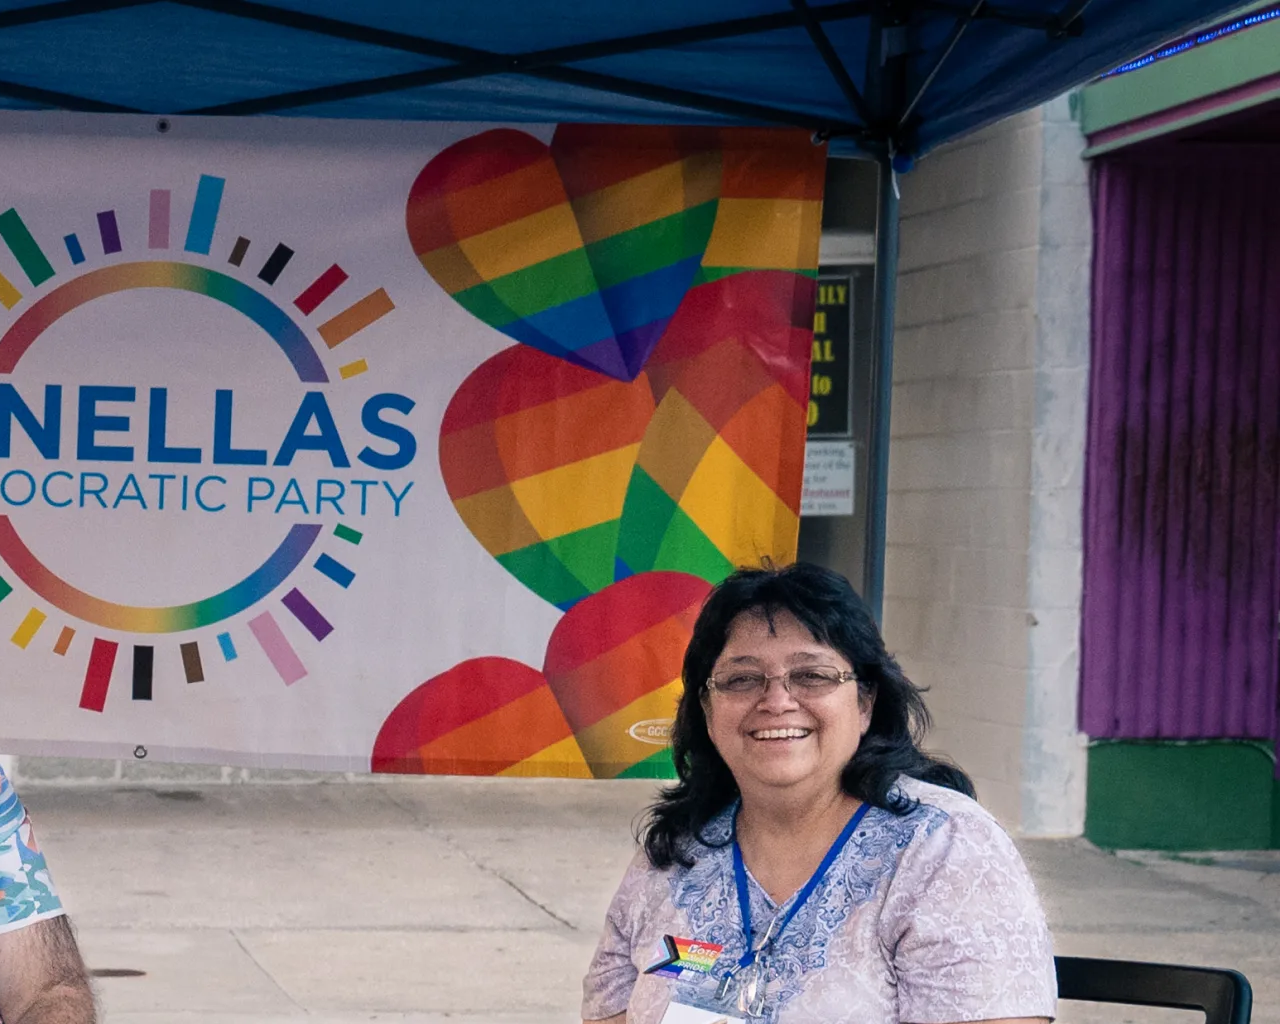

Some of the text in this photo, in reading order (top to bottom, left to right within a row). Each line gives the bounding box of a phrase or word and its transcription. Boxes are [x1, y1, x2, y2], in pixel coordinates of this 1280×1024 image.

[247, 477, 416, 518] PARTY
[687, 944, 718, 958] VOTE
[677, 961, 707, 973] PRIDE
